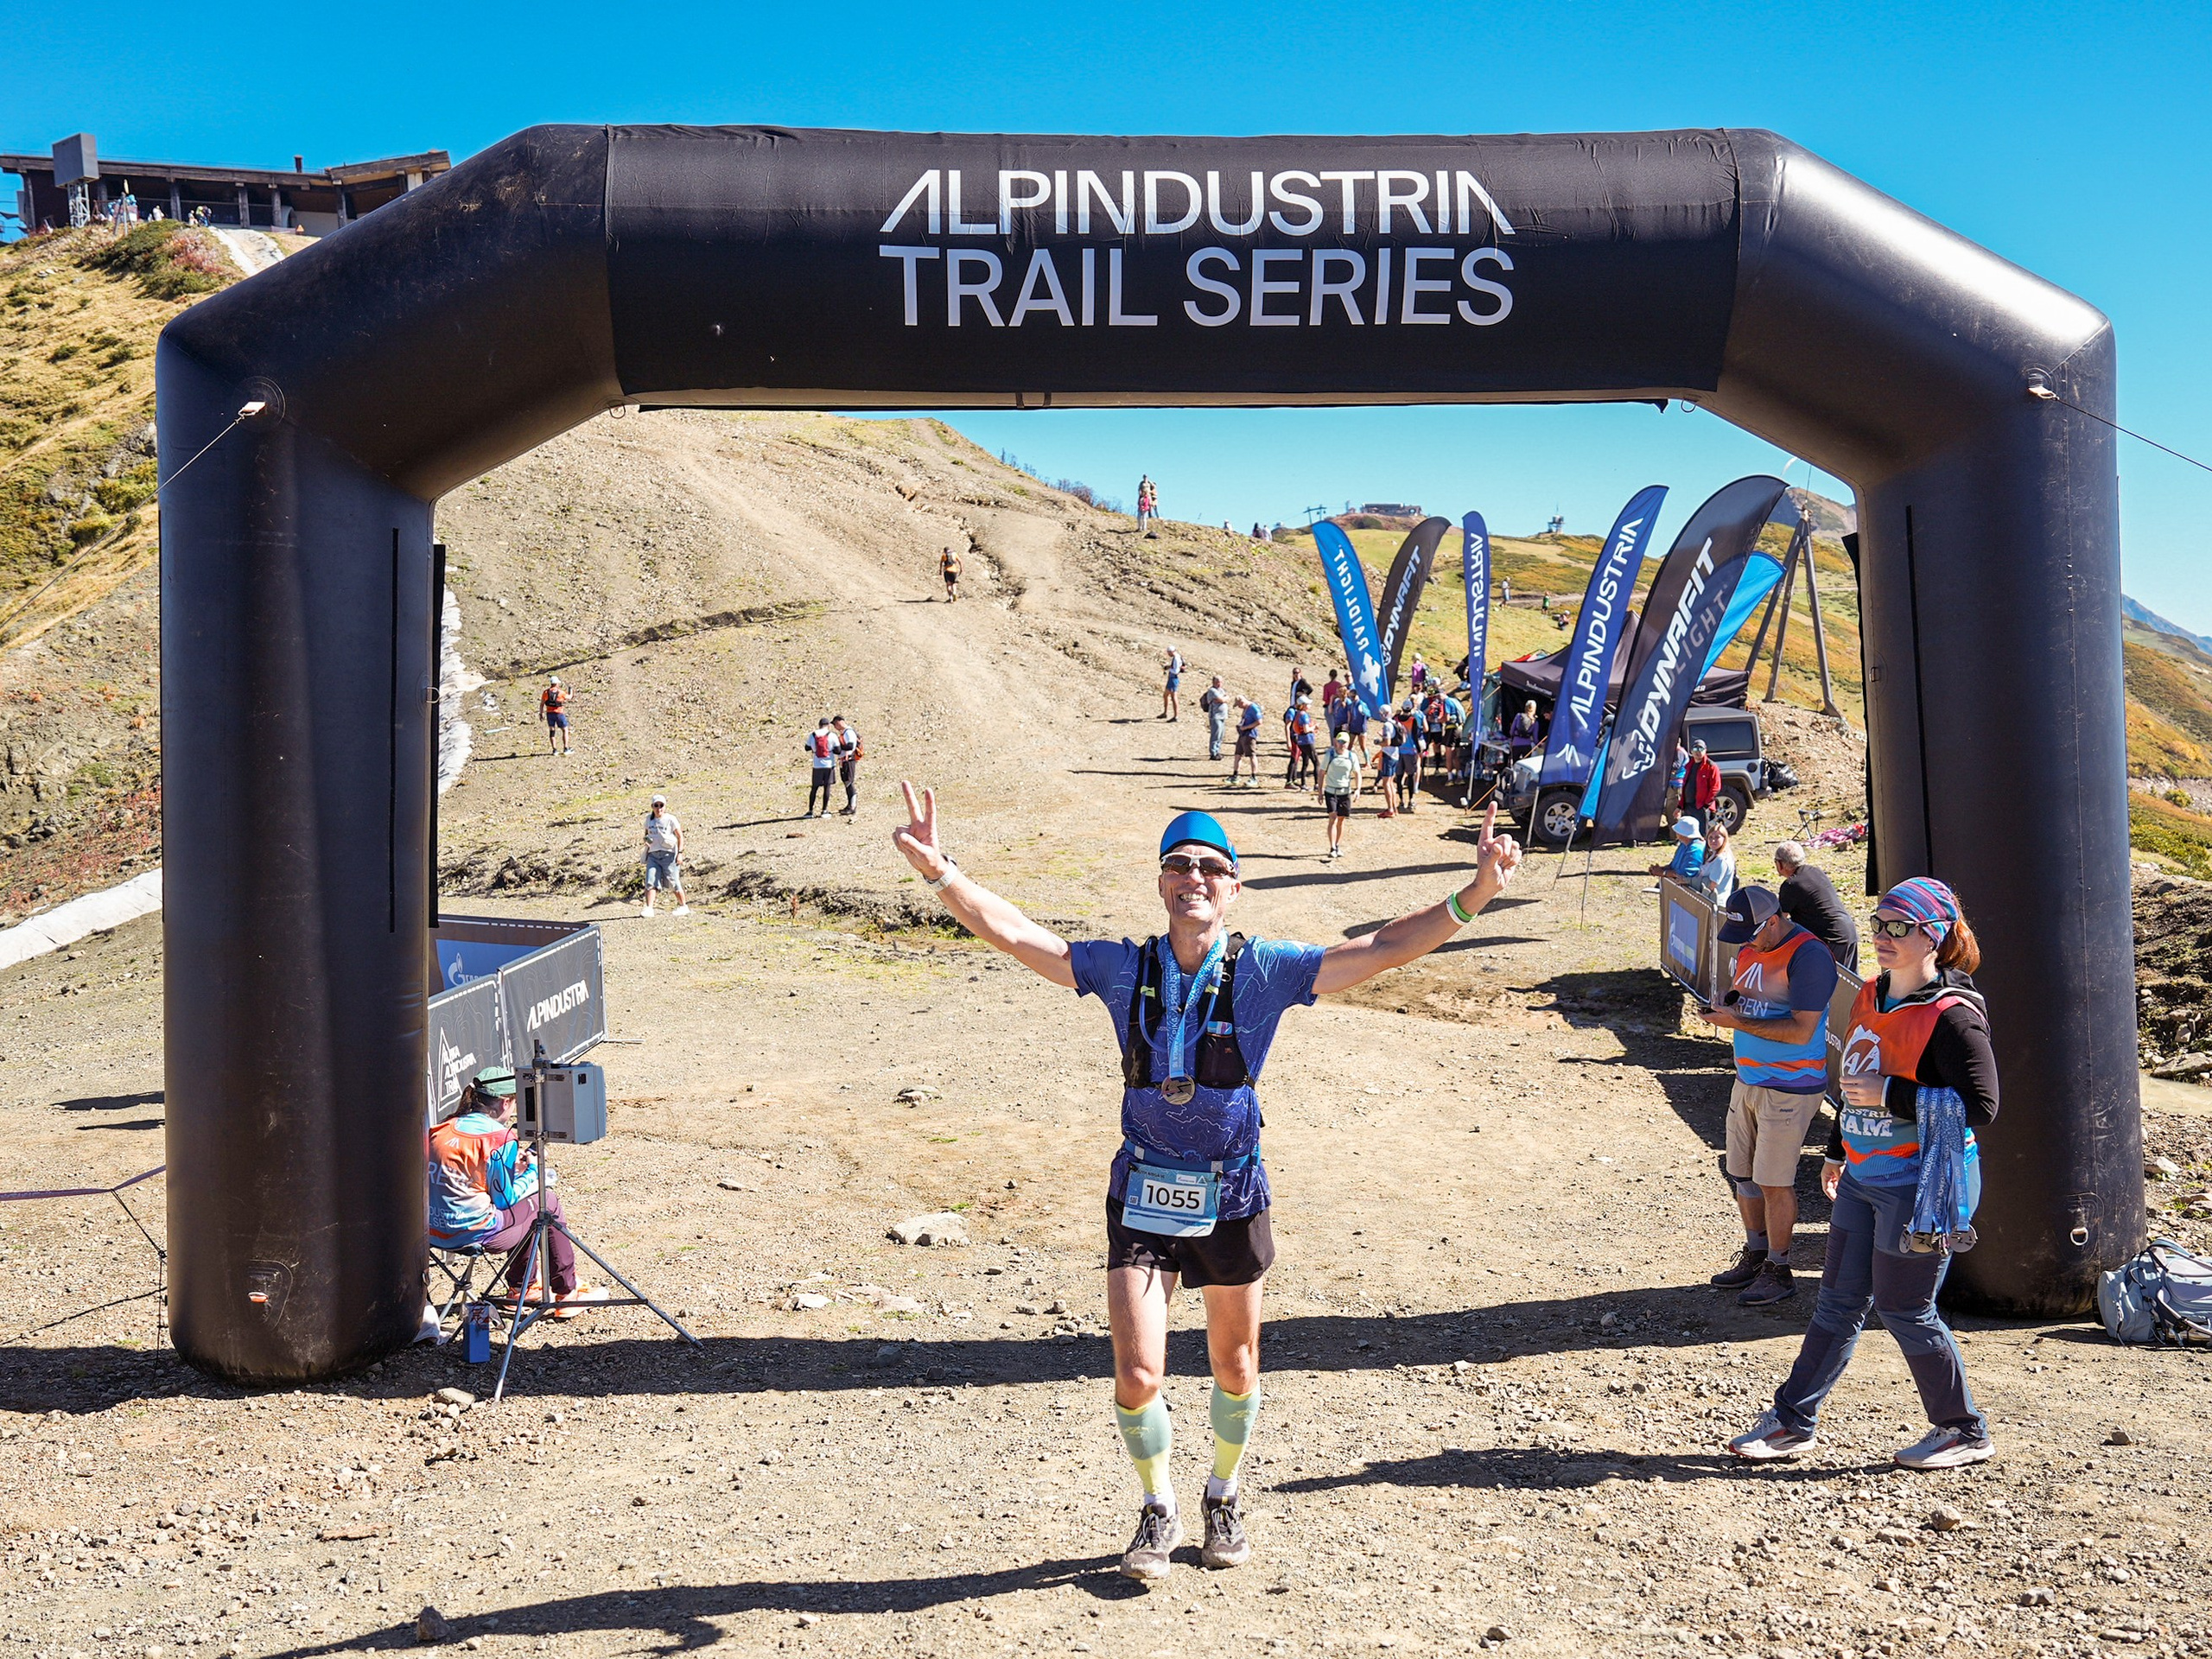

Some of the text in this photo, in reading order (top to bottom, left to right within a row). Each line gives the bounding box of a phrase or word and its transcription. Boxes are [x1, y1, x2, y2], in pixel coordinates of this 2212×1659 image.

[879, 169, 1516, 235] ALPINDUSTRIA
[878, 245, 1516, 327] TRAIL SERIES
[1383, 544, 1421, 651] DYNAFIT
[1571, 518, 1644, 729] ALPINDUSTRIA
[1640, 537, 1717, 741] DYNAFIT
[527, 979, 590, 1033] ALPINDUSTRIA
[1737, 995, 1769, 1018] REW
[1147, 1184, 1200, 1210] 1055
